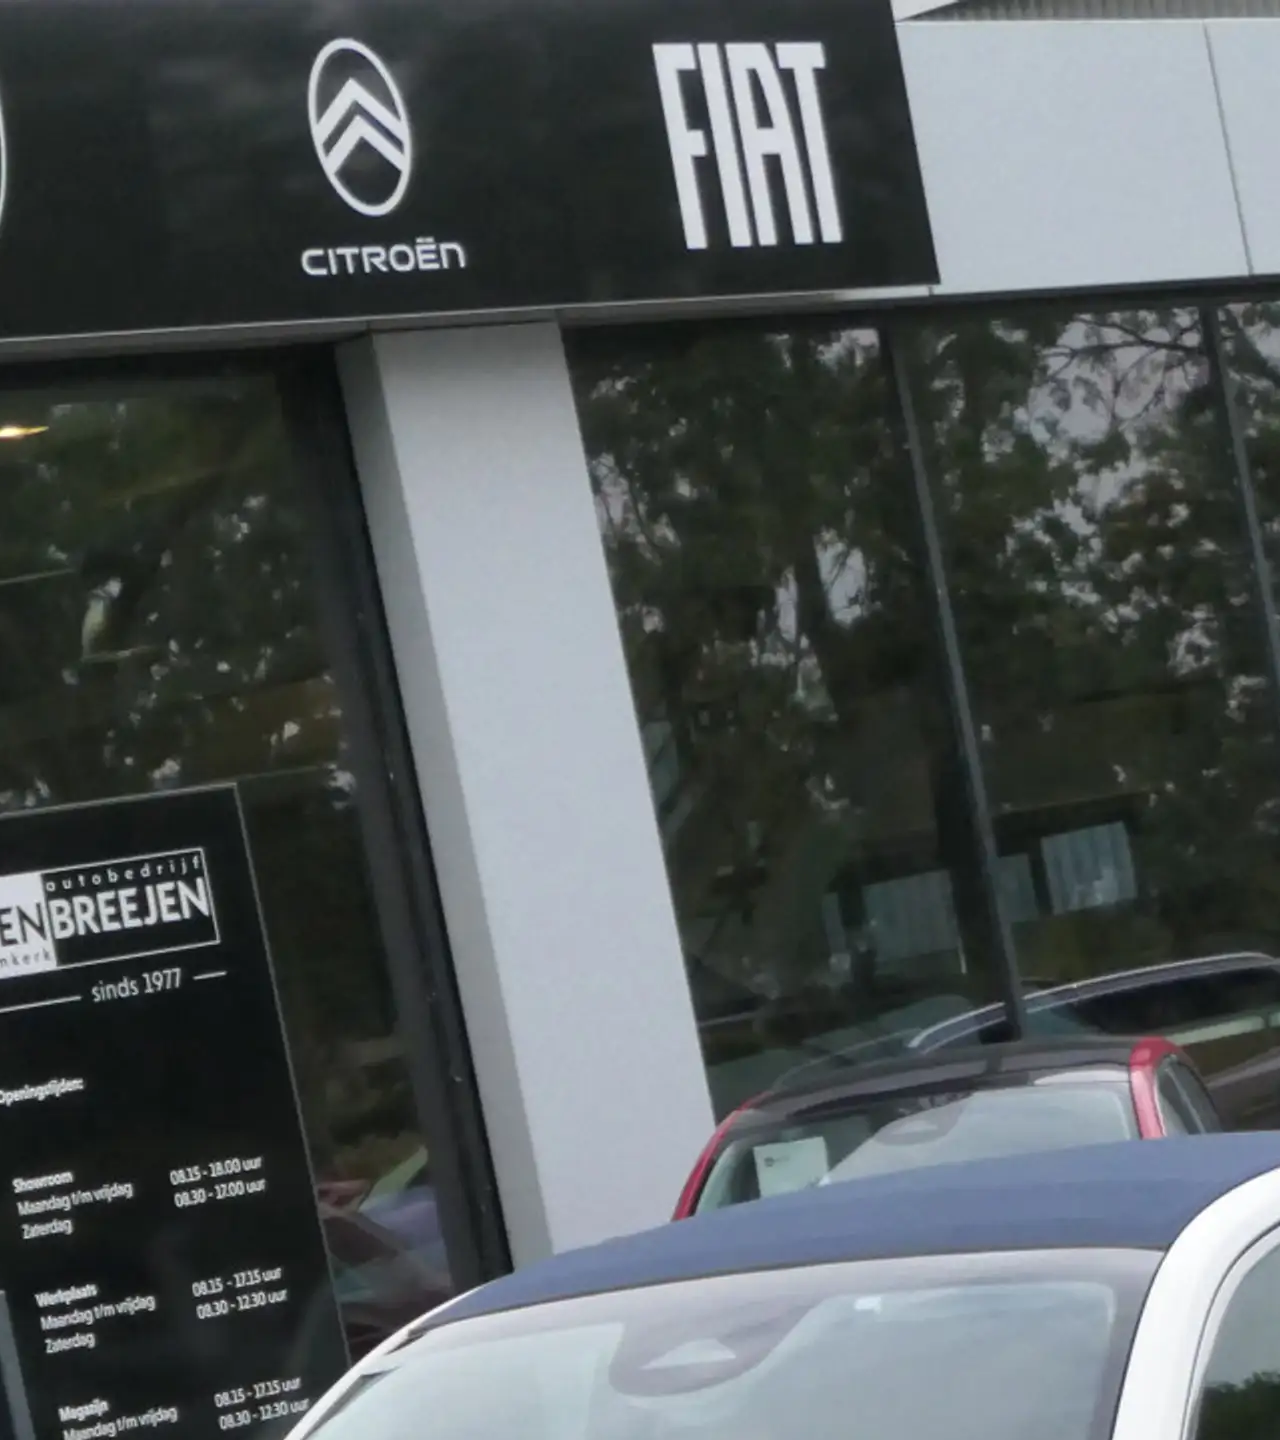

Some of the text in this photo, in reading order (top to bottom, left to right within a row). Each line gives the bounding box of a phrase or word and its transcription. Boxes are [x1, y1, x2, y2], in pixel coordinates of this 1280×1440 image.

[652, 41, 843, 250] FIAT
[45, 854, 201, 892] autobedrijf
[48, 877, 210, 940] BREEJEN
[91, 967, 182, 1003] sinds 1977
[12, 1170, 74, 1194] Showroom
[16, 1194, 71, 1216] Maandag
[21, 1218, 73, 1240] Zaterdag
[40, 1308, 94, 1331] Maandag
[45, 1332, 96, 1354] Zaterdag
